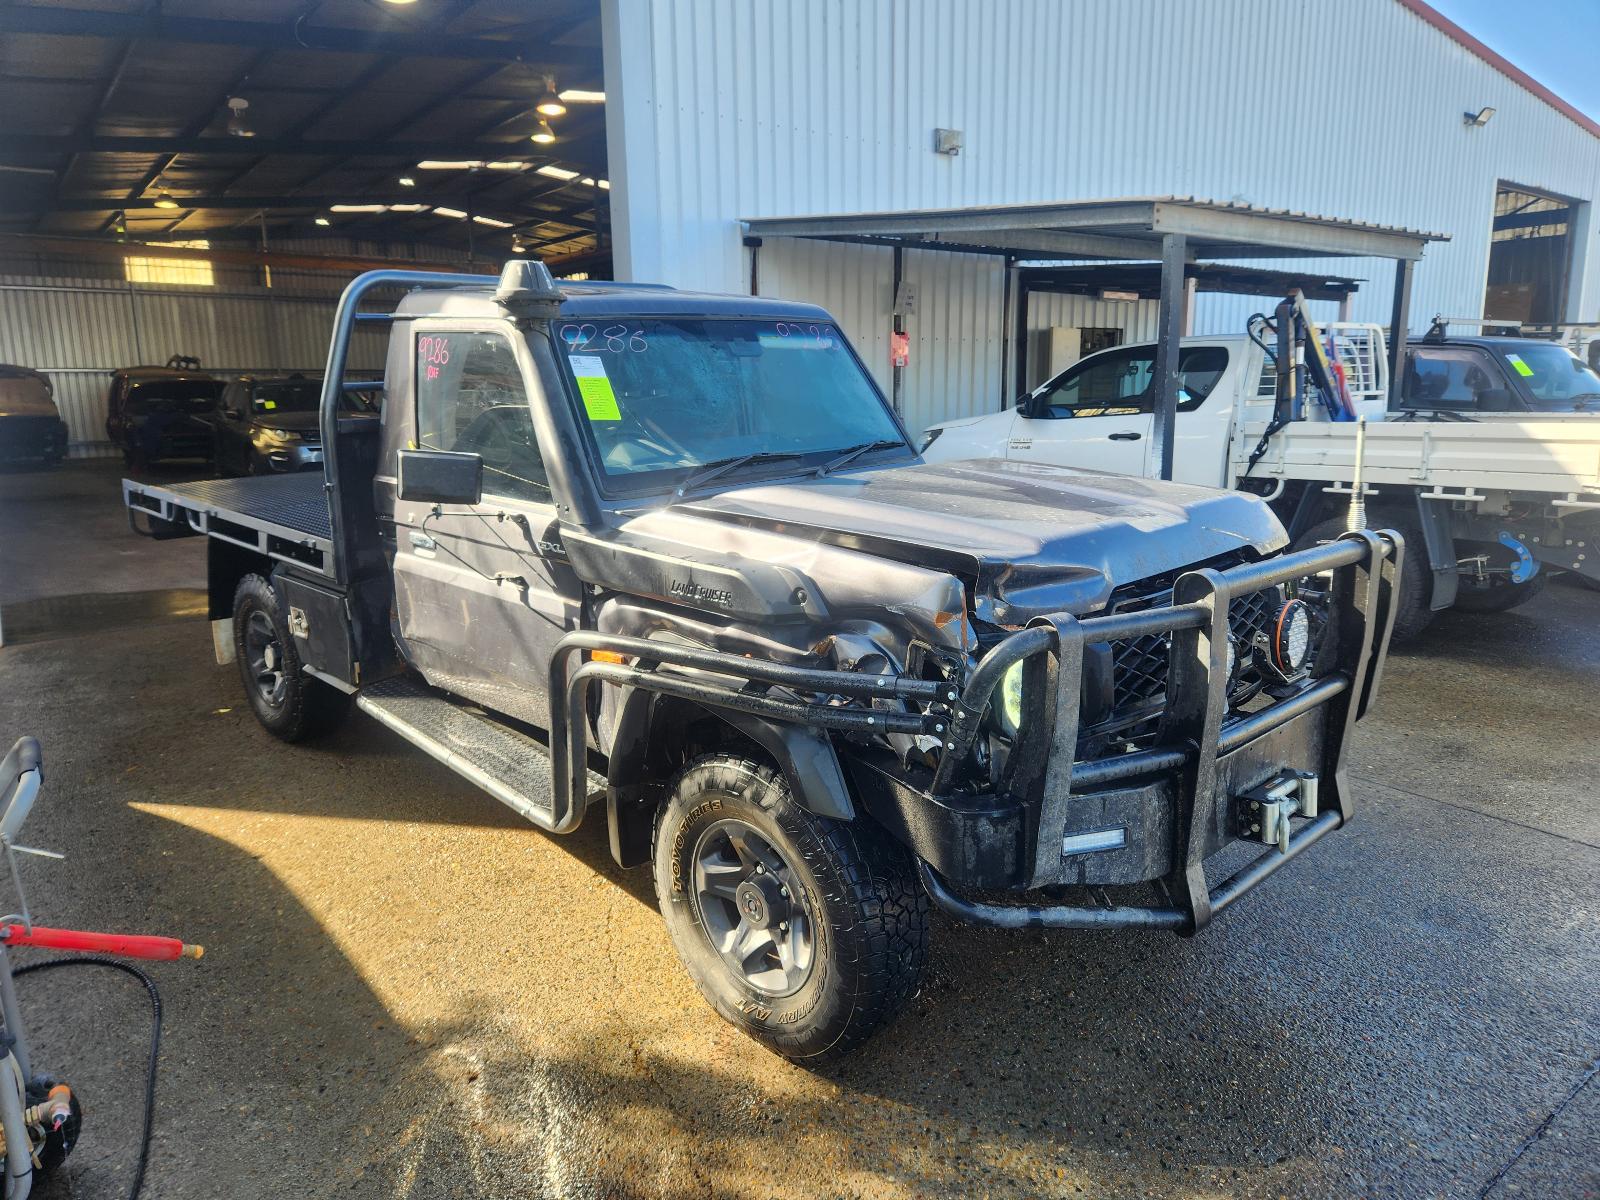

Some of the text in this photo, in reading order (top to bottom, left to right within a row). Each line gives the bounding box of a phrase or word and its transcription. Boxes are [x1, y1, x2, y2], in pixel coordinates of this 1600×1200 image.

[419, 336, 449, 365] 9286
[560, 324, 648, 353] 9286
[536, 540, 566, 555] GXL
[671, 799, 723, 893] TOYO TIRES
[734, 998, 773, 1022] A/T
